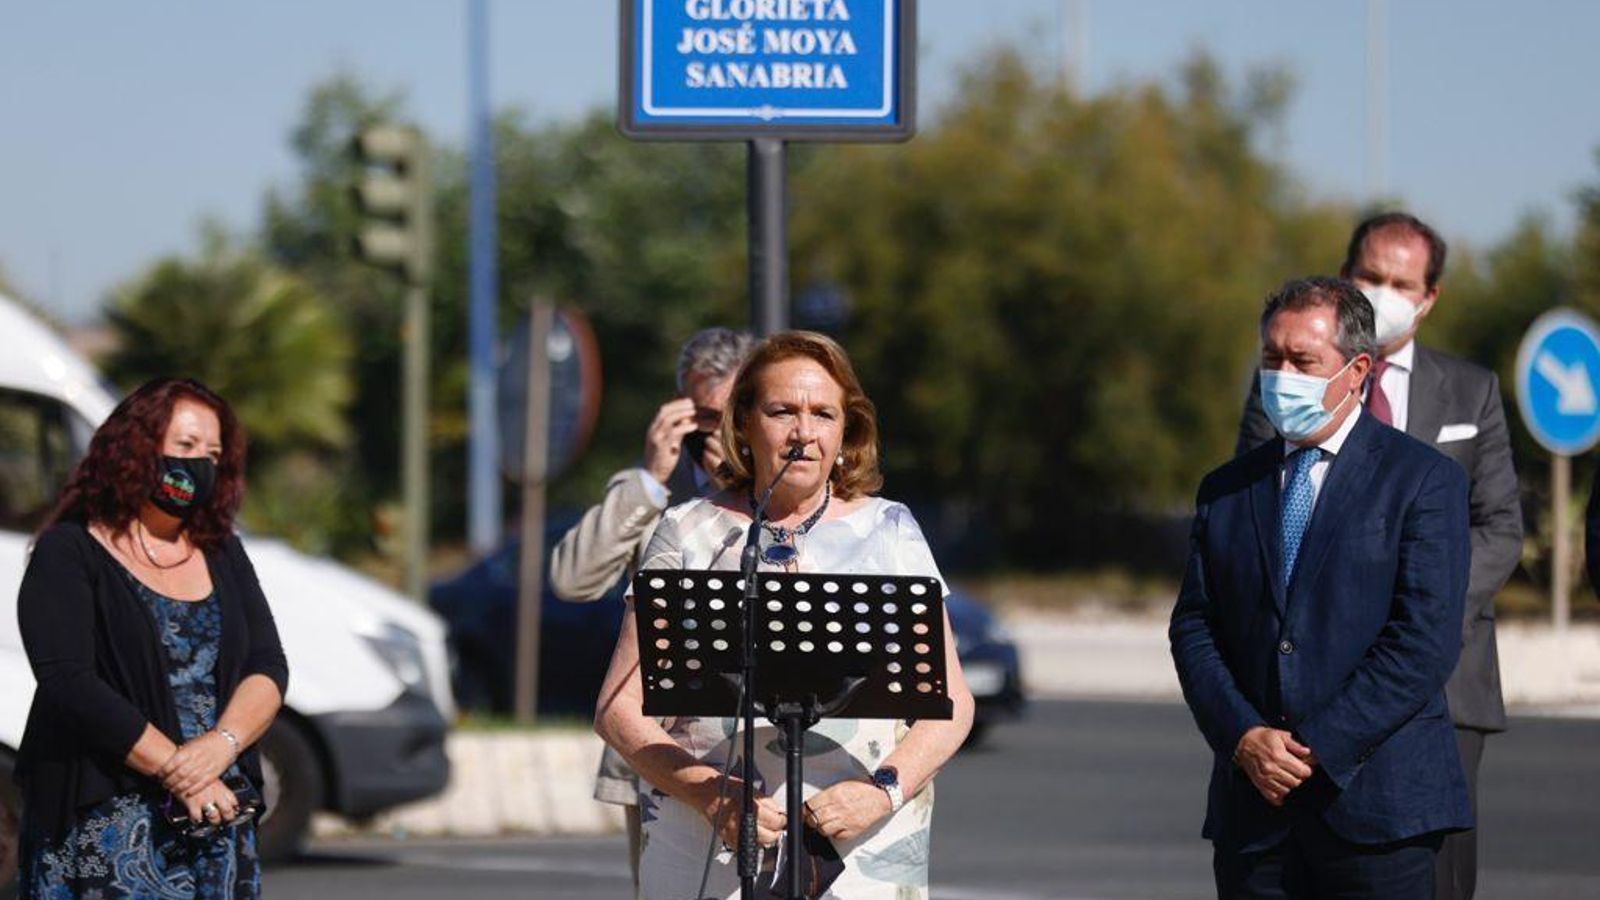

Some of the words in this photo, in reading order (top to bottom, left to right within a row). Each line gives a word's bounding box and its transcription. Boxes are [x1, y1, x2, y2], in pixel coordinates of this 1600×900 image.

[685, 0, 850, 20] GLORIETA
[677, 23, 756, 54] JOSÉ
[763, 29, 857, 54] MOYA
[686, 62, 848, 88] SANABRIA
